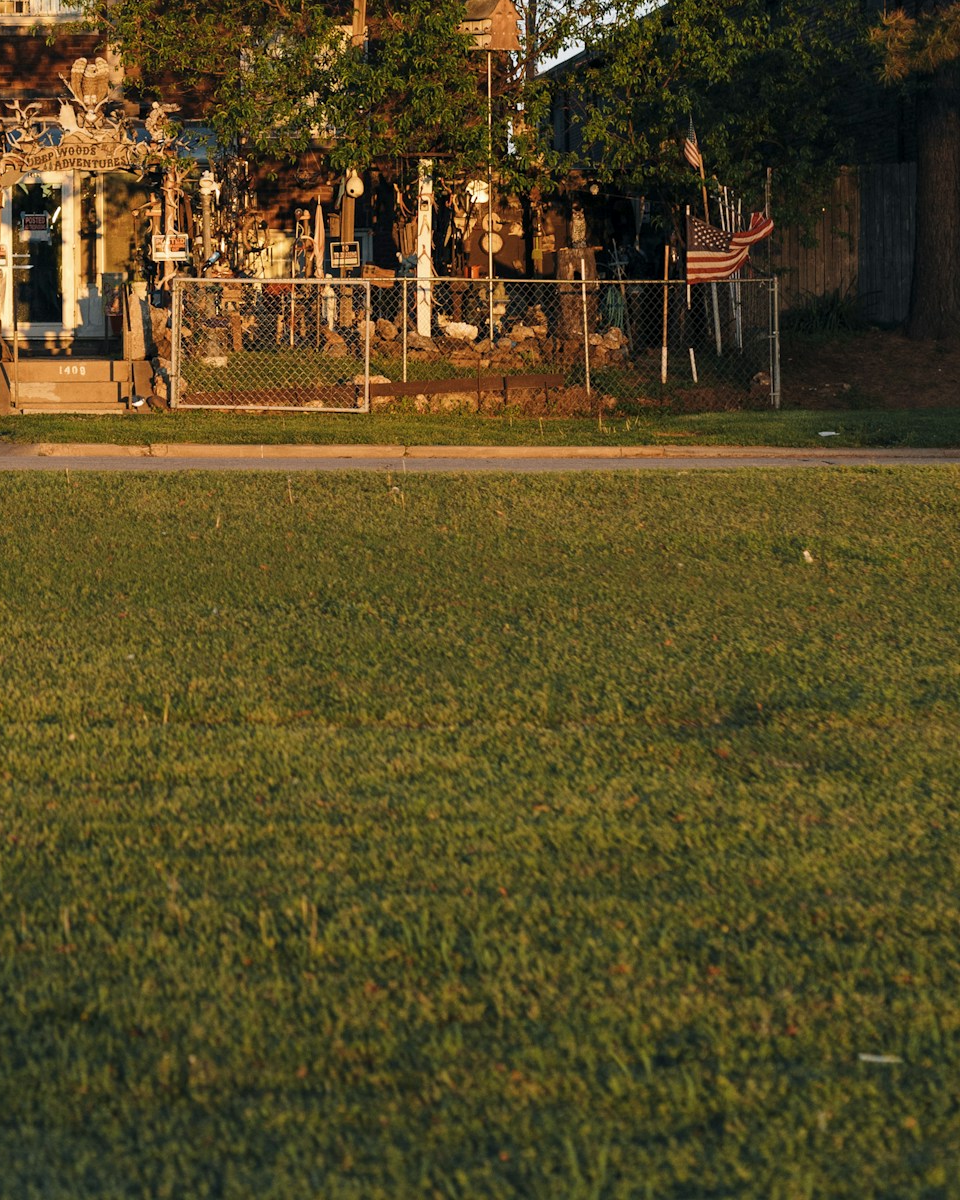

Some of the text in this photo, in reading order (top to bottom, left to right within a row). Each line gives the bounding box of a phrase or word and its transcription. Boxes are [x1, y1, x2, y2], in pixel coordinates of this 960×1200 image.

[26, 146, 97, 166] DEEP WOODS
[55, 155, 126, 170] ADVENTURES
[25, 216, 46, 224] POSTED
